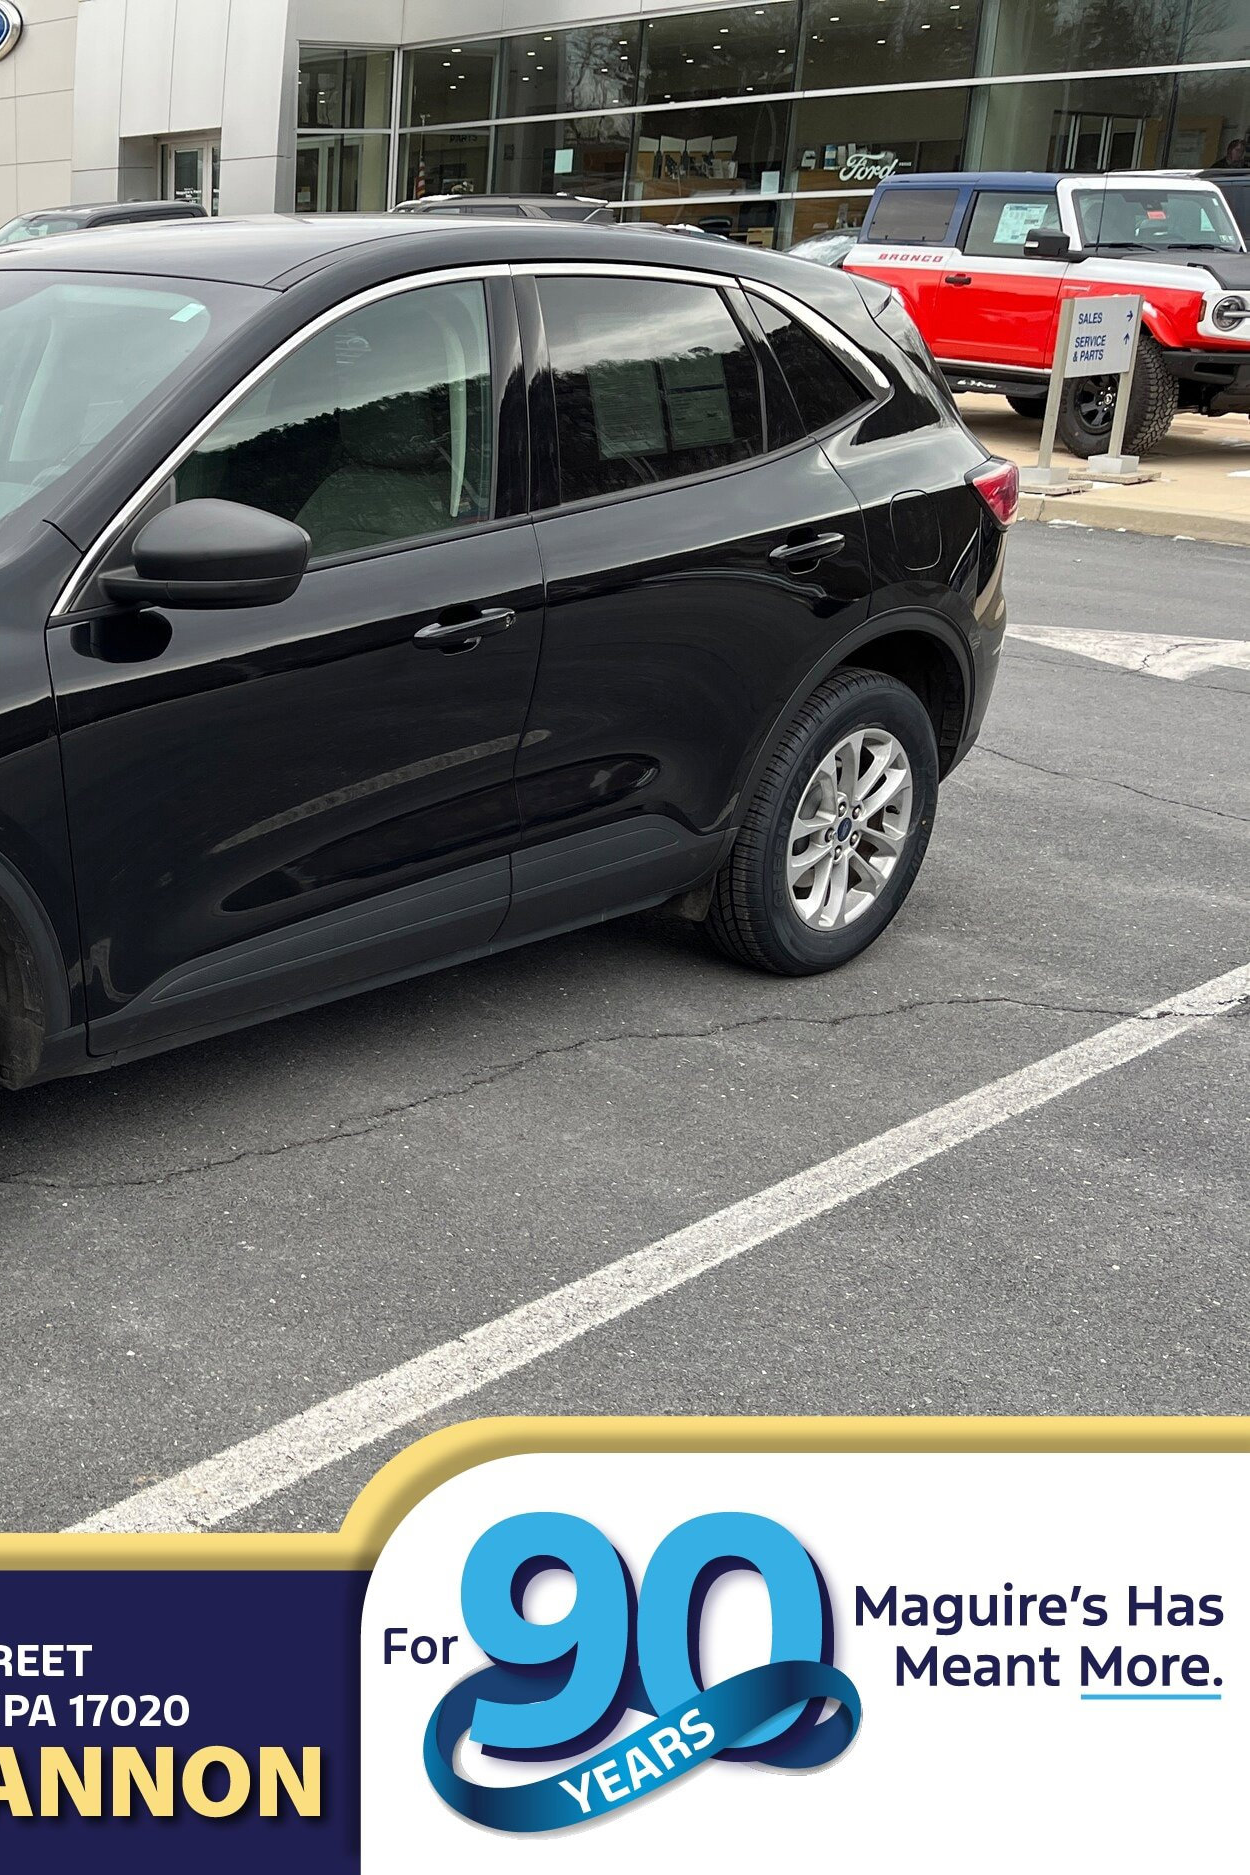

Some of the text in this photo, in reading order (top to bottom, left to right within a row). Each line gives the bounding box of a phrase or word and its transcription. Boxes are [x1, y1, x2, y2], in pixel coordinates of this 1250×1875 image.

[839, 151, 899, 182] Ford
[878, 253, 944, 264] BRONCO
[1078, 311, 1103, 325] SALES
[1074, 334, 1107, 349] SERVICE
[1072, 348, 1104, 362] & PARTS
